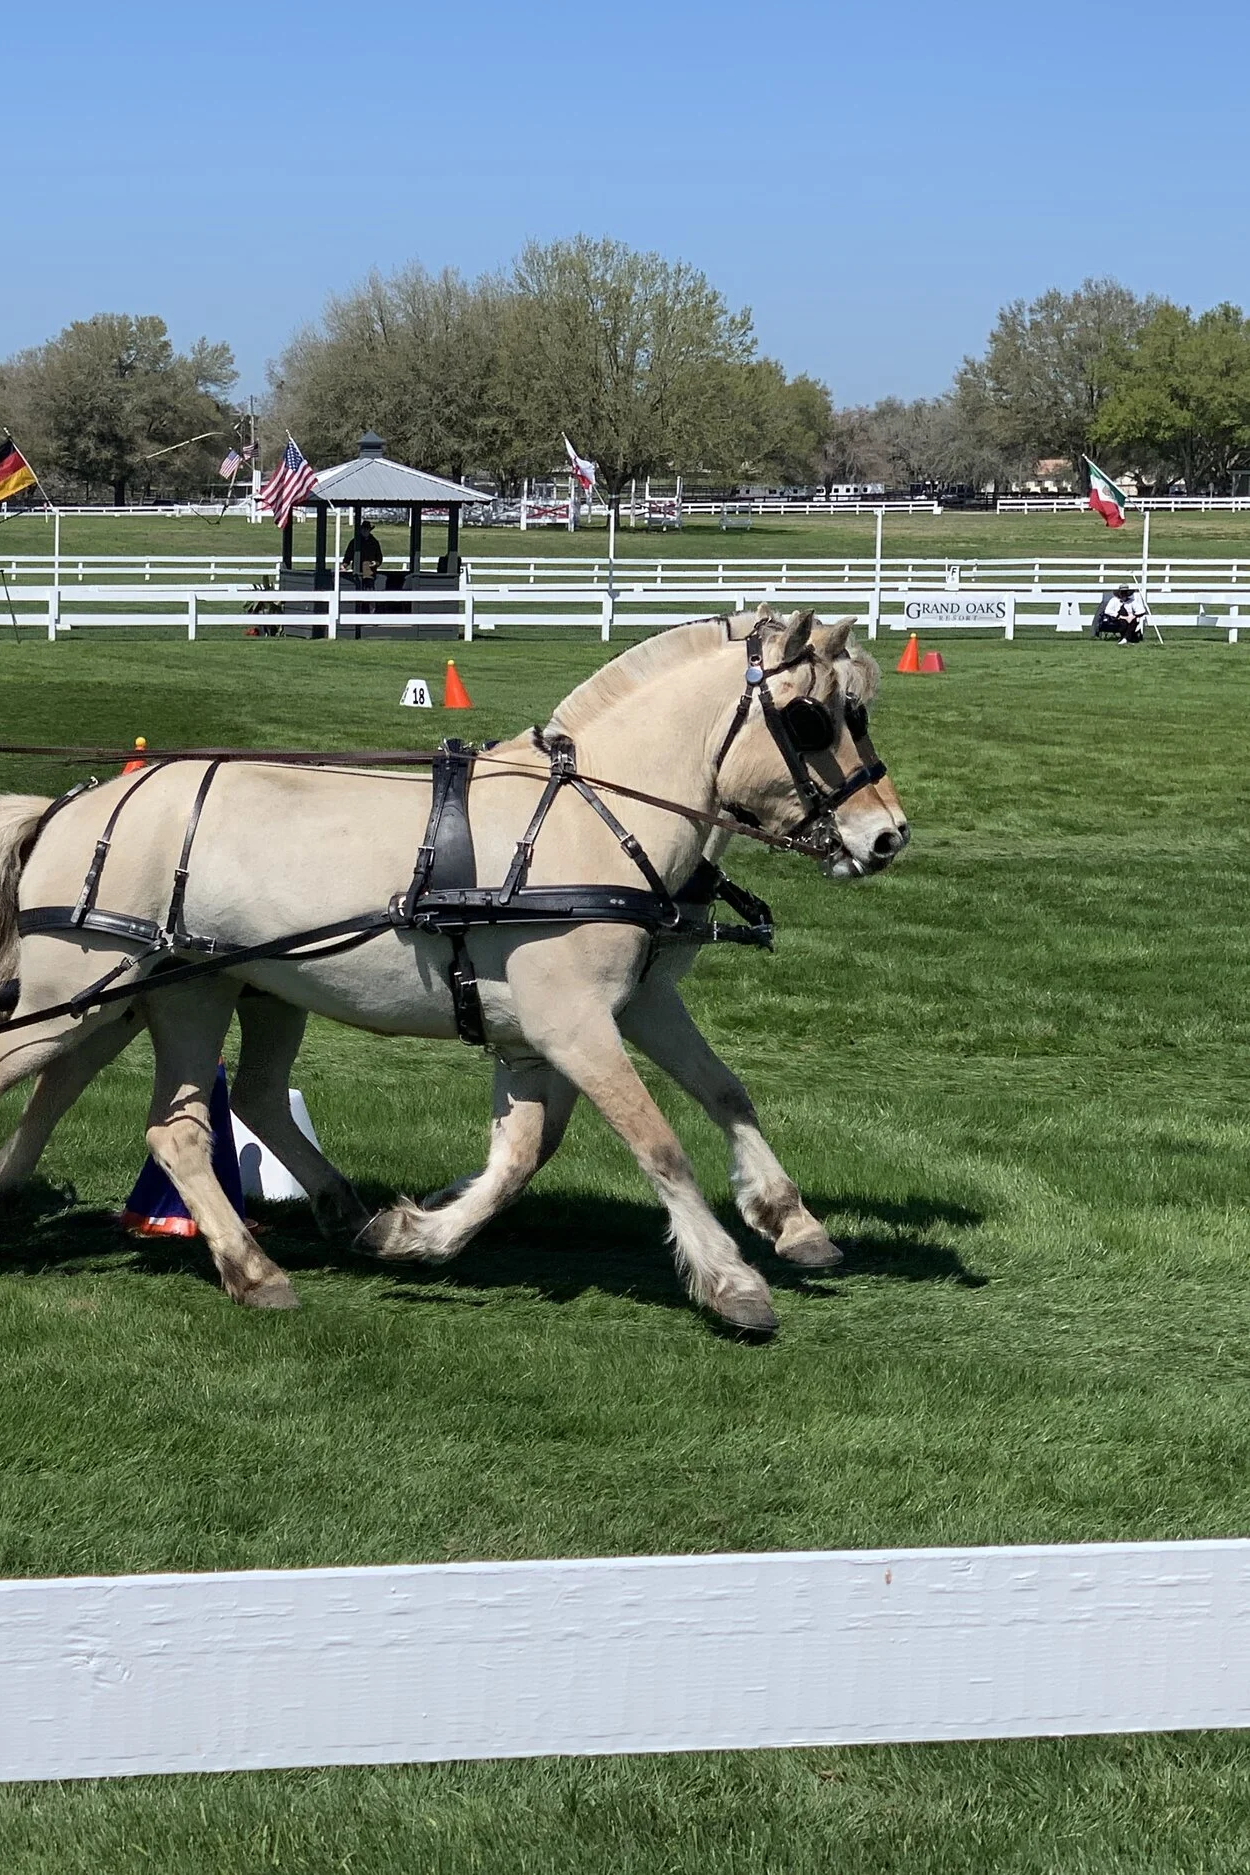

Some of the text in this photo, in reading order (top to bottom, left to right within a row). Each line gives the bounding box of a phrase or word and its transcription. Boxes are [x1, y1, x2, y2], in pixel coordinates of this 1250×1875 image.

[951, 567, 957, 577] F
[906, 601, 1006, 619] GRAND OAKS
[413, 688, 425, 705] 18
